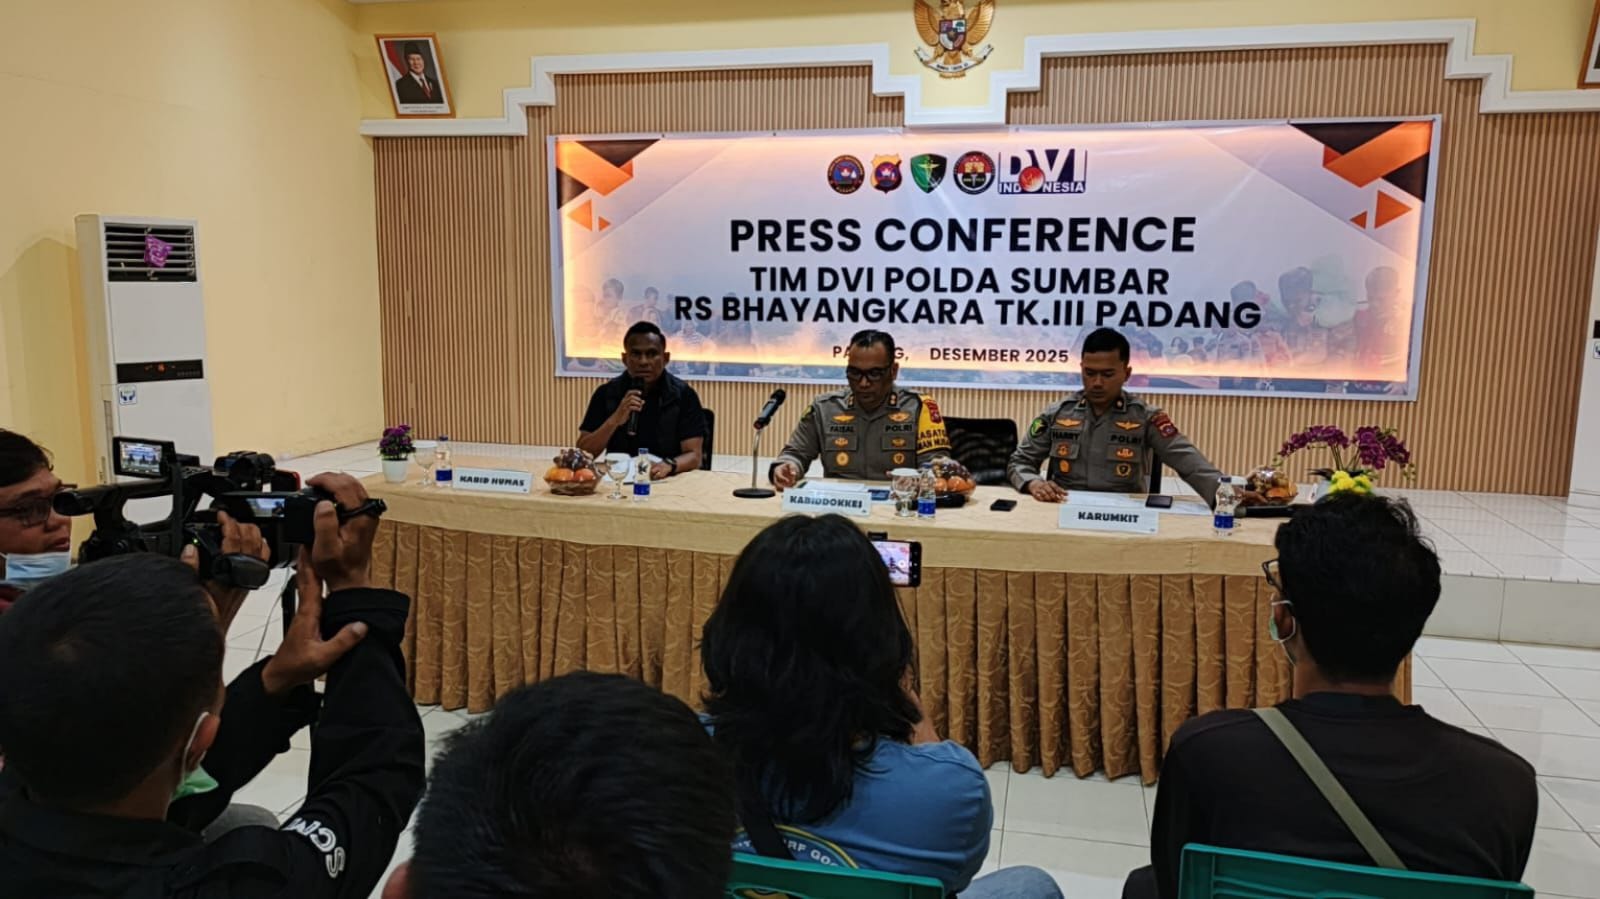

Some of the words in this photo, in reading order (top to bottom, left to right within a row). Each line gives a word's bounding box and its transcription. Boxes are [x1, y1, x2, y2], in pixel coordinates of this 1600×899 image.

[1000, 148, 1085, 182] DVI
[730, 218, 861, 252] PRESS
[875, 217, 1197, 252] CONFERENCE
[750, 267, 807, 292] TIM
[817, 267, 874, 292] DVI
[885, 267, 1000, 293] POLDA
[1010, 267, 1170, 295] SUMBAR
[674, 296, 713, 321] RS
[722, 297, 984, 325] BHAYANGKARA
[994, 299, 1085, 326] TK.III
[1095, 301, 1262, 329] PADANG
[930, 347, 1020, 362] DESEMBER
[1025, 349, 1069, 362] 2025
[885, 424, 913, 432] POLRI
[1110, 434, 1142, 443] POLRI
[459, 475, 490, 484] KABID
[491, 477, 525, 487] HUMAS
[1078, 511, 1139, 523] KARUMKIT
